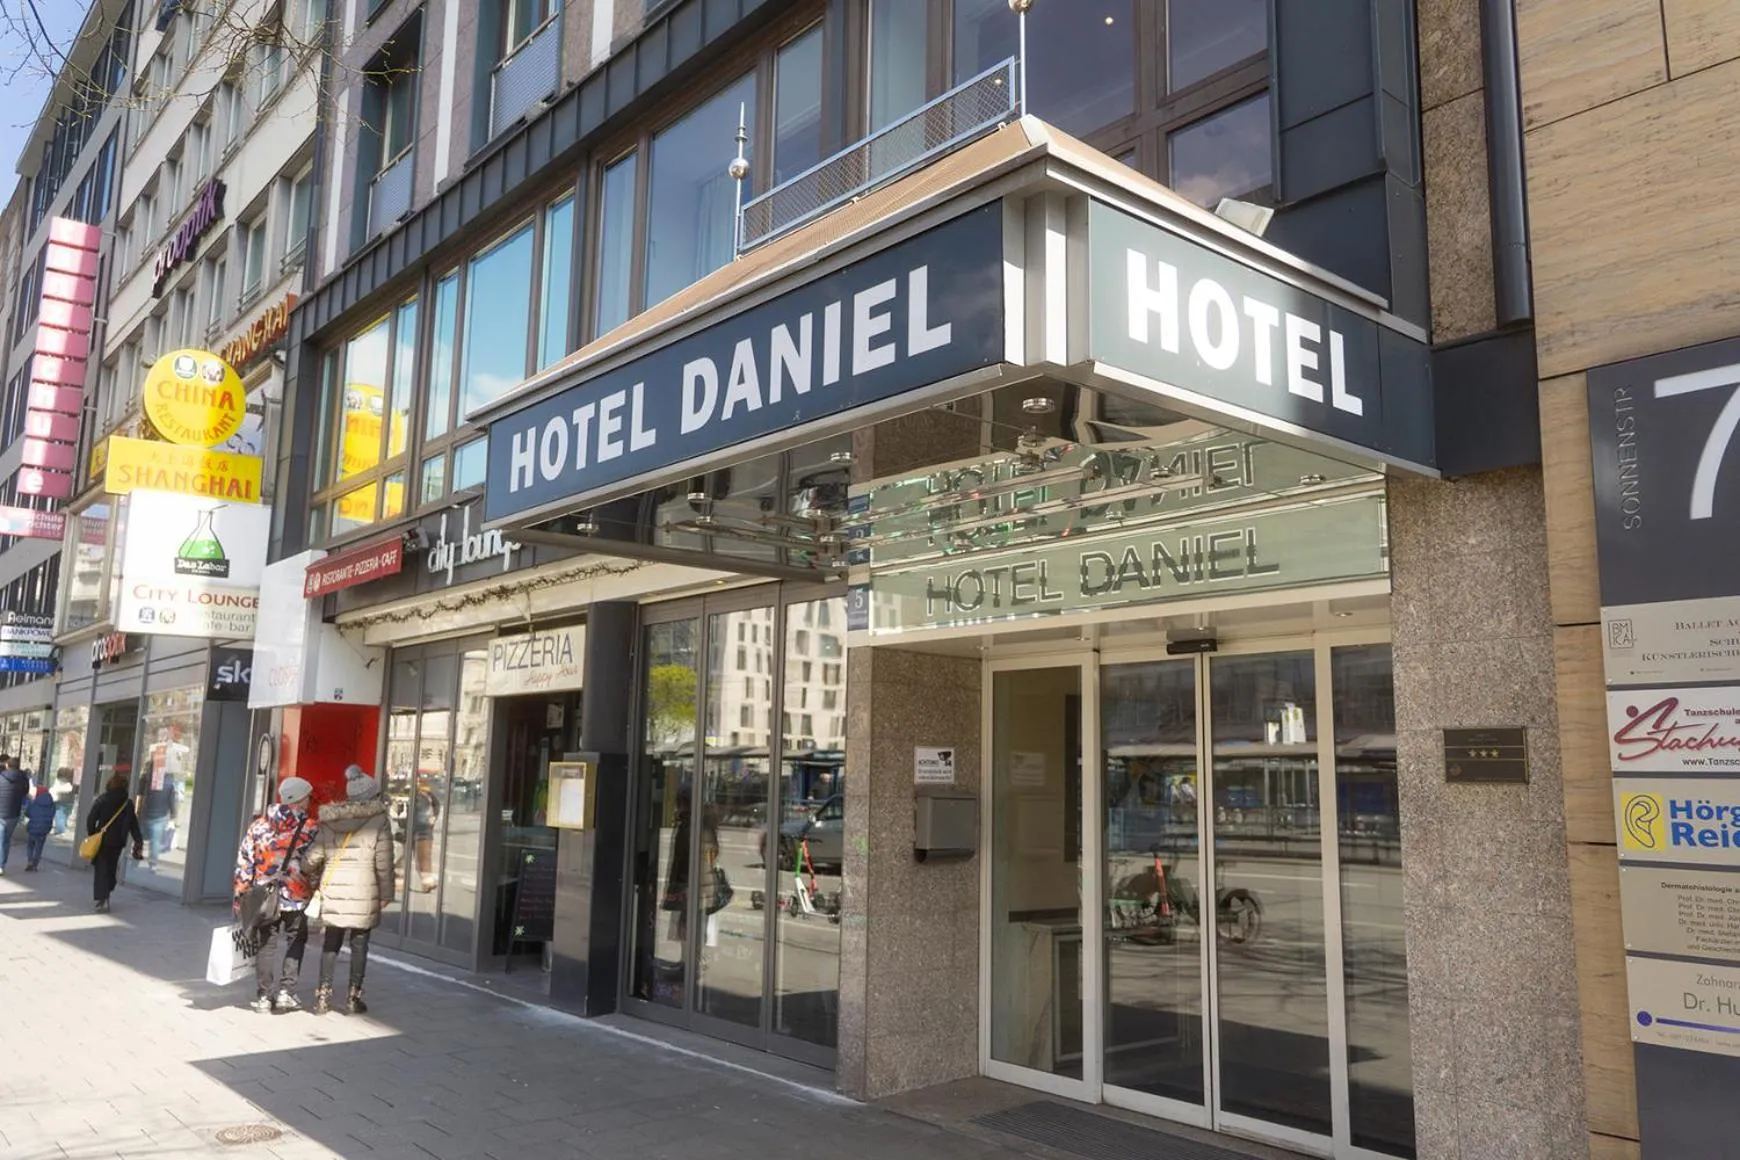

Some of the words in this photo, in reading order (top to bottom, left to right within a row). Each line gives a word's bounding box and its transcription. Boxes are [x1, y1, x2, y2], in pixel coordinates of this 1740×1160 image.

[1126, 247, 1363, 416] HOTEL
[157, 381, 235, 410] CHINA
[509, 382, 656, 494] HOTEL
[680, 264, 953, 435] DANIEL
[1653, 364, 1740, 521] 7
[118, 464, 253, 499] SHANGHAI
[926, 559, 1064, 617] HOTEL
[1080, 527, 1280, 597] DANIEL
[493, 633, 573, 672] PIZZERIA
[215, 660, 251, 686] sk
[1683, 992, 1711, 1012] Dr.
